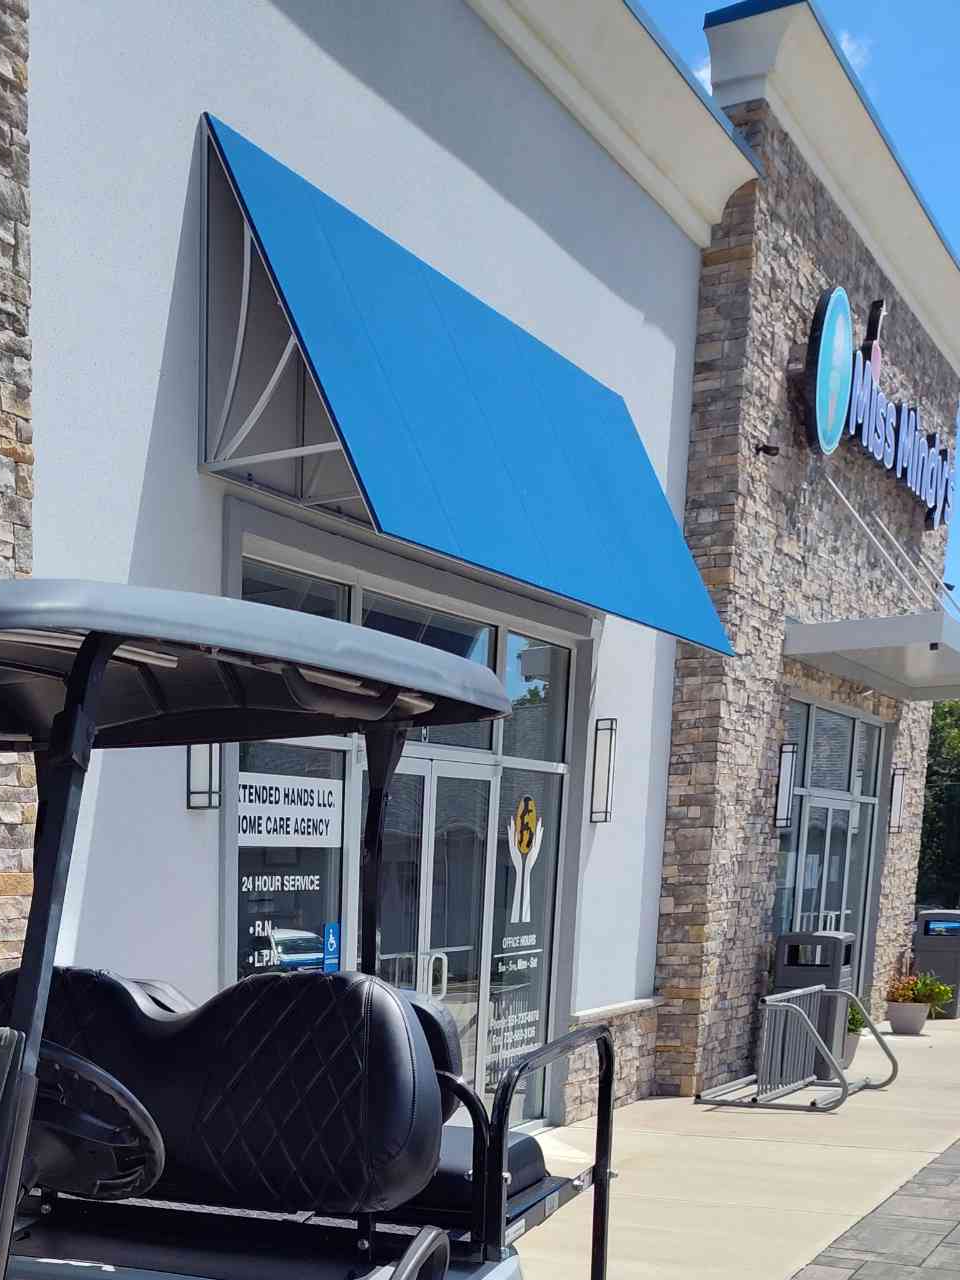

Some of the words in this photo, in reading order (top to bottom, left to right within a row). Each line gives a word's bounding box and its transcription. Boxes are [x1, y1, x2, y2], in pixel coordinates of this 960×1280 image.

[849, 350, 896, 470] Miss
[283, 787, 315, 807] HANDS
[317, 789, 335, 808] LLC.
[265, 815, 291, 836] CARE
[293, 817, 330, 837] AGENCY
[241, 876, 253, 892] 24
[254, 876, 281, 892] HOUR
[283, 875, 320, 891] SERVICE
[502, 936, 519, 949] OFFICE
[520, 934, 537, 947] HOURS
